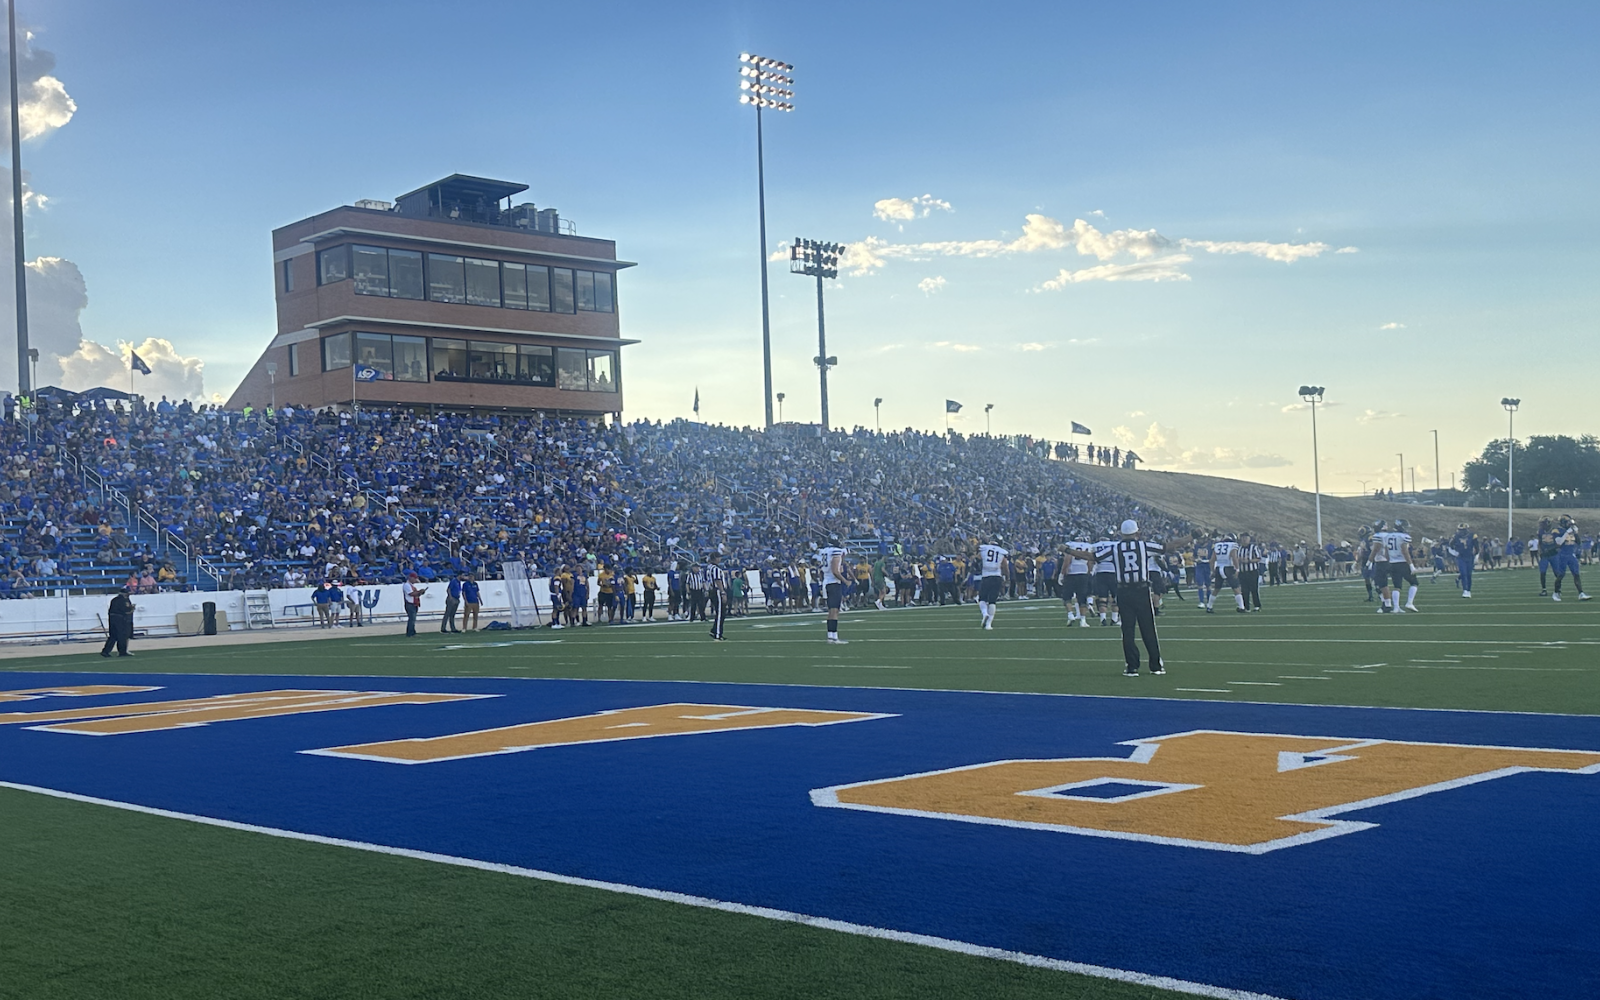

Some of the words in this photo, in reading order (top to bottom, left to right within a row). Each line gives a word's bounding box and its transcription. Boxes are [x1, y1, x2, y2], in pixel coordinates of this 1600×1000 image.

[1216, 544, 1229, 555] 33
[1387, 537, 1398, 550] 51
[986, 549, 999, 563] 91
[1122, 551, 1140, 571] R
